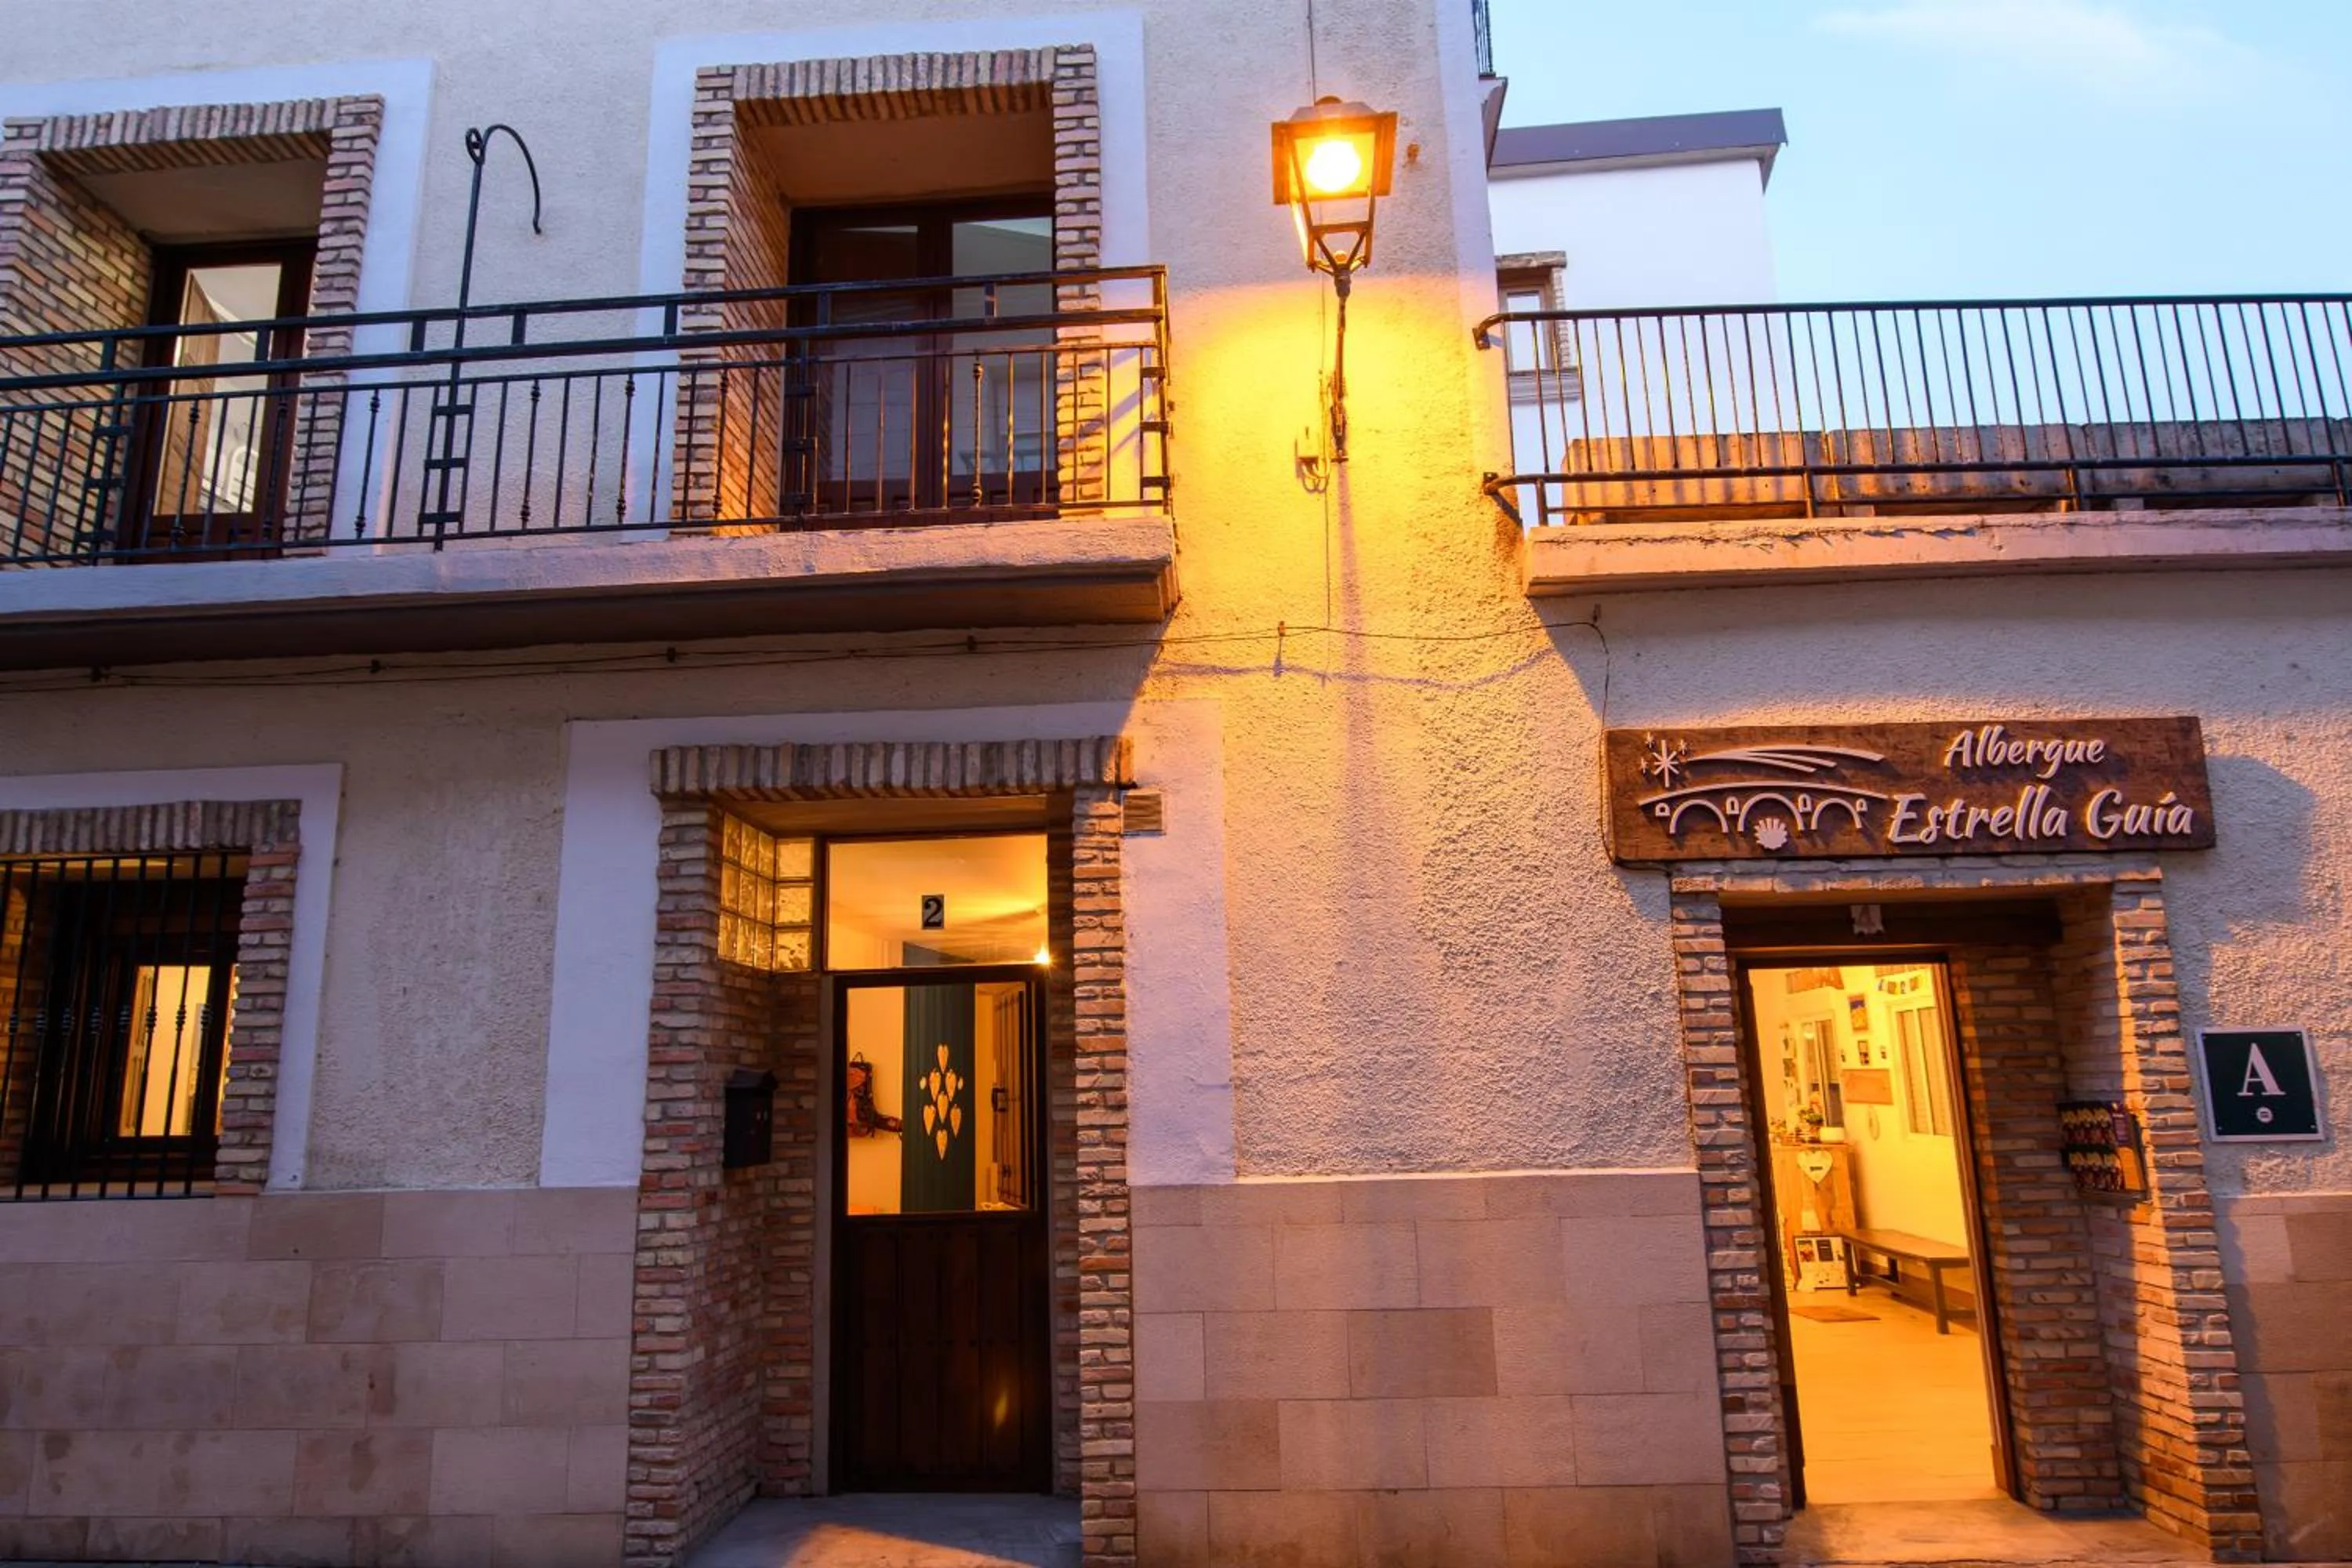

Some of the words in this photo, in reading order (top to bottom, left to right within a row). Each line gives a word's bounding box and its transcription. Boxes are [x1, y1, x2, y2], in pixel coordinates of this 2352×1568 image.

[1944, 724, 2105, 779] Albergue
[1887, 784, 2069, 844] Estrella
[2085, 788, 2194, 840] Guía
[924, 897, 943, 927] 2
[2237, 1042, 2287, 1096] A
